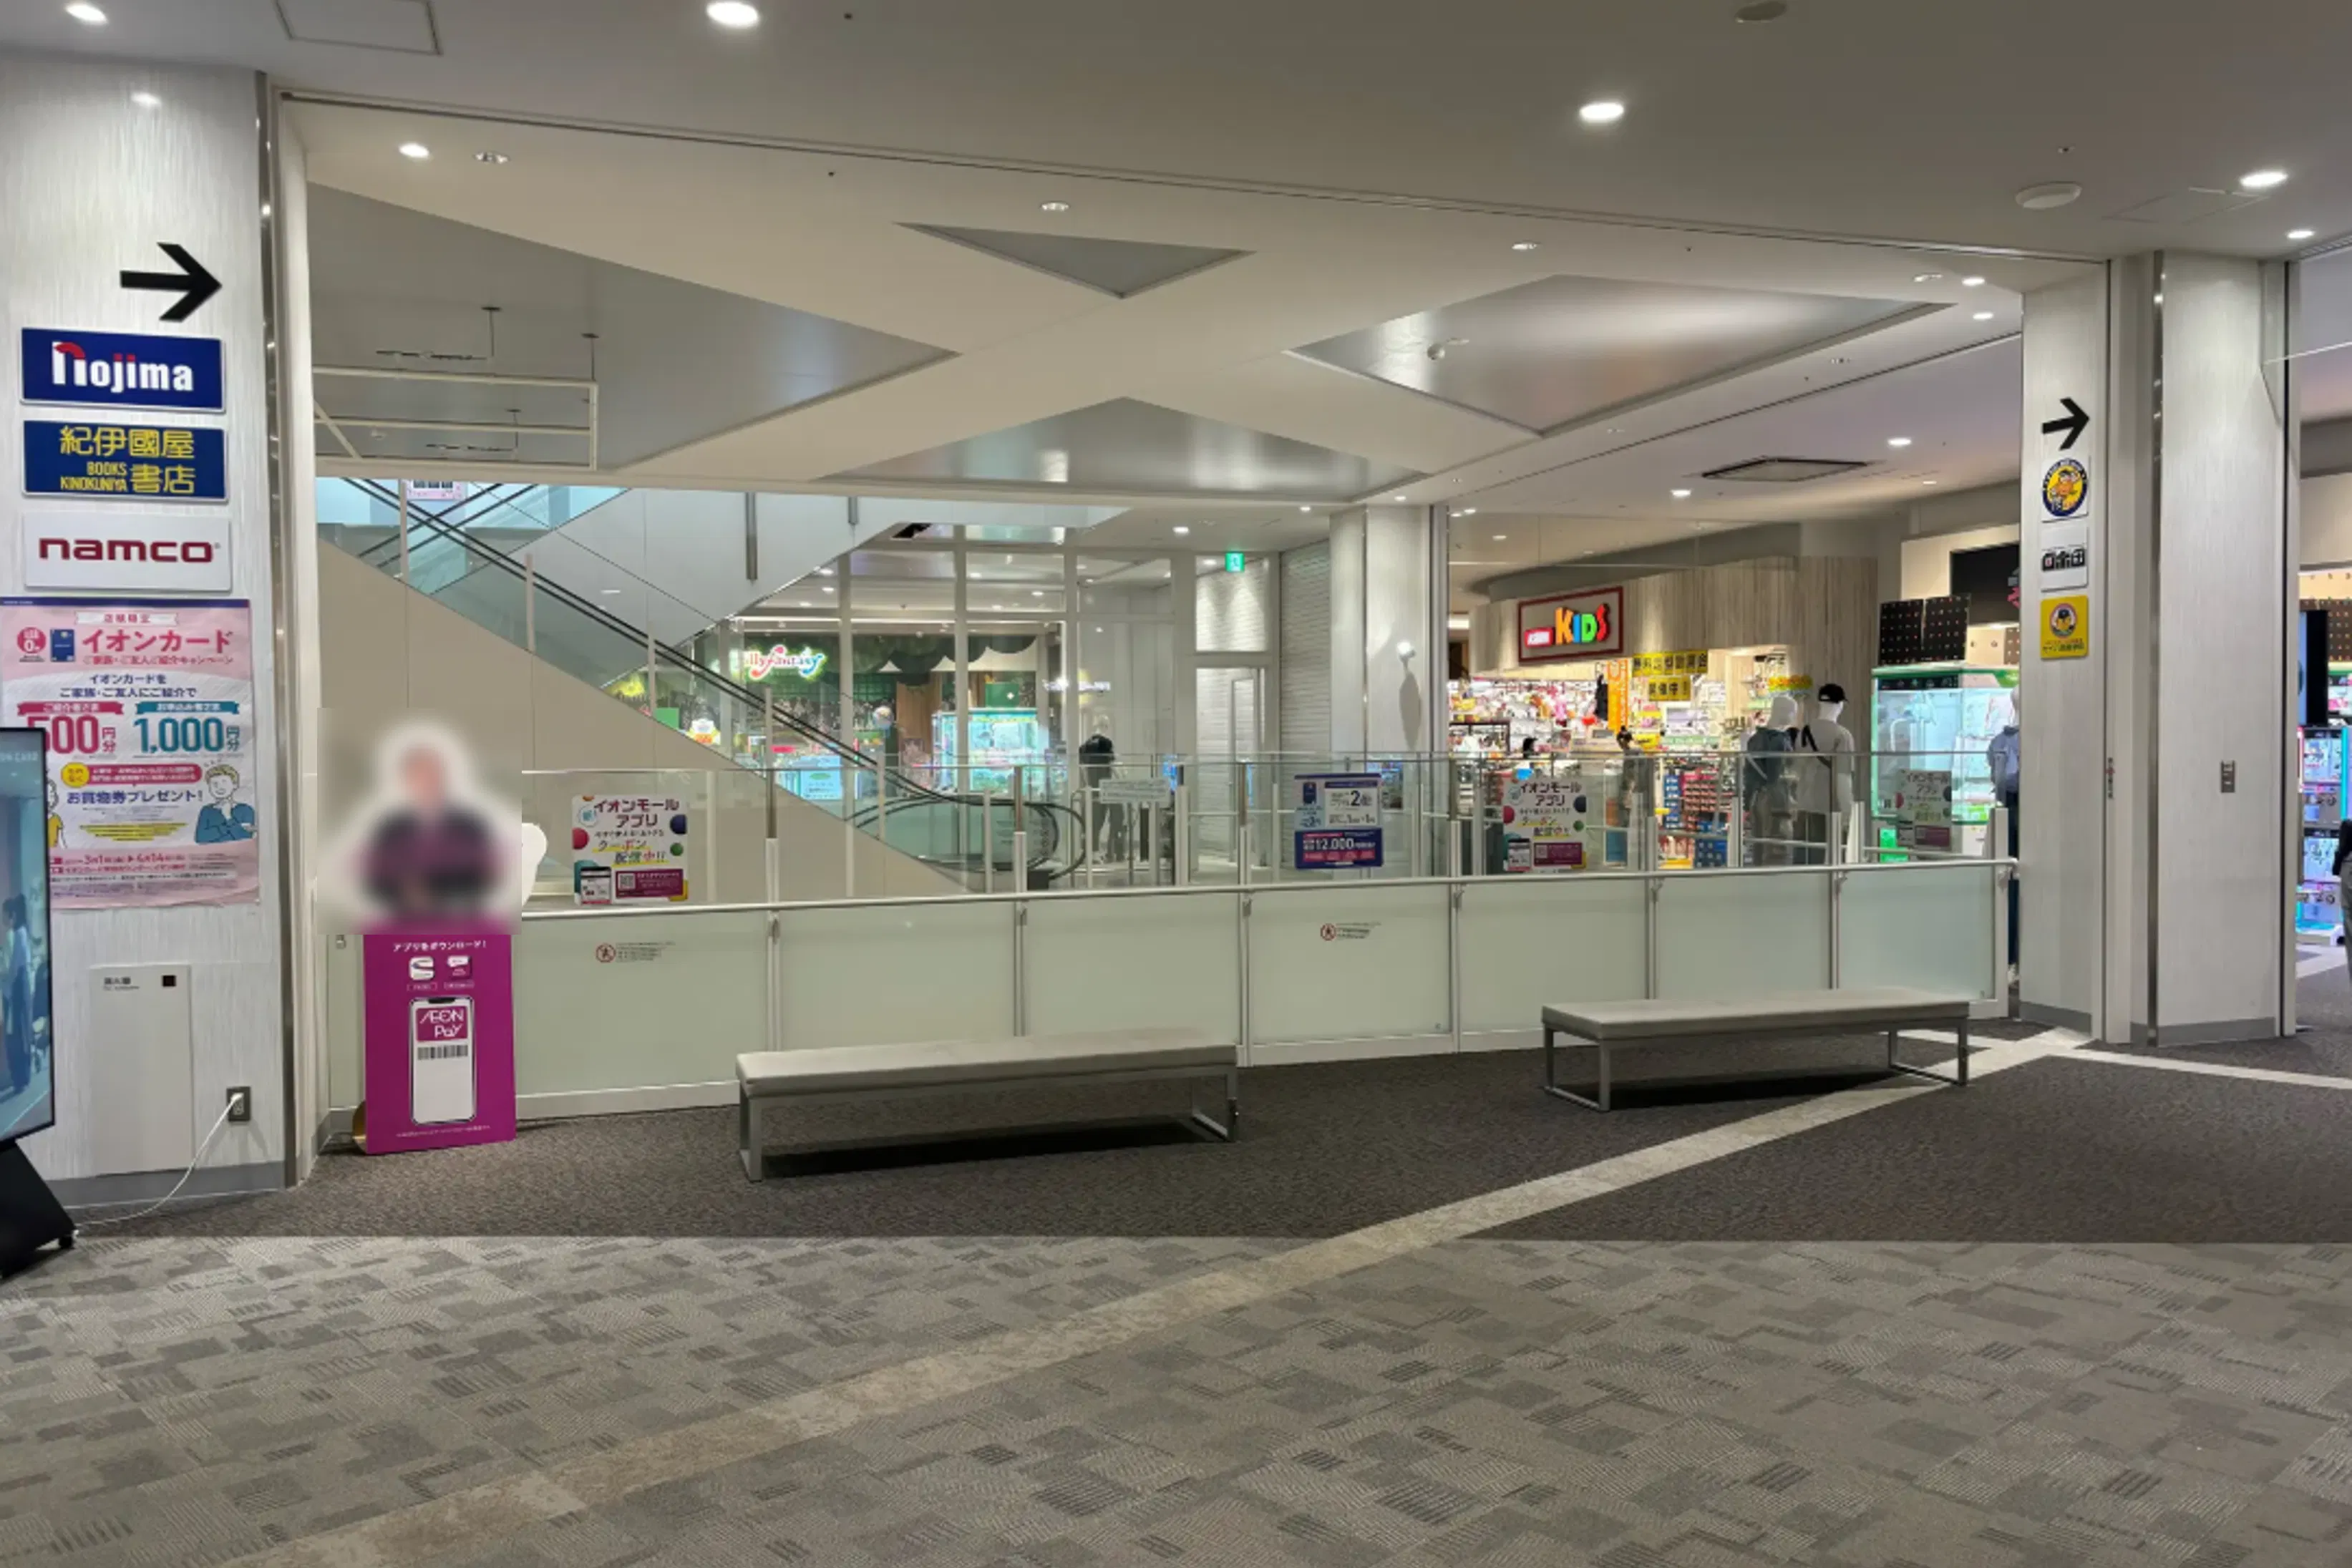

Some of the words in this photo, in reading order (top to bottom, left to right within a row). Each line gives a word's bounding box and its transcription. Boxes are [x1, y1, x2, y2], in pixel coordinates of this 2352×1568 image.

[52, 341, 194, 393] nojima
[59, 425, 195, 459] 紀伊國屋
[87, 461, 127, 476] BOOKS
[60, 476, 128, 492] KINOKUNIYA
[130, 463, 196, 494] 書店
[39, 537, 213, 563] namco
[1555, 603, 1608, 646] KIDS
[82, 628, 234, 654] イオンカード
[89, 673, 167, 685] イオンカードを
[133, 716, 225, 754] 1,000
[1520, 781, 1583, 793] イオンモール
[593, 798, 680, 813] イオンモール
[1535, 794, 1565, 807] アプリ
[616, 814, 659, 829] アプリ
[598, 839, 647, 852] クーポン
[419, 1009, 464, 1024] AEON
[434, 1024, 462, 1038] Pay
